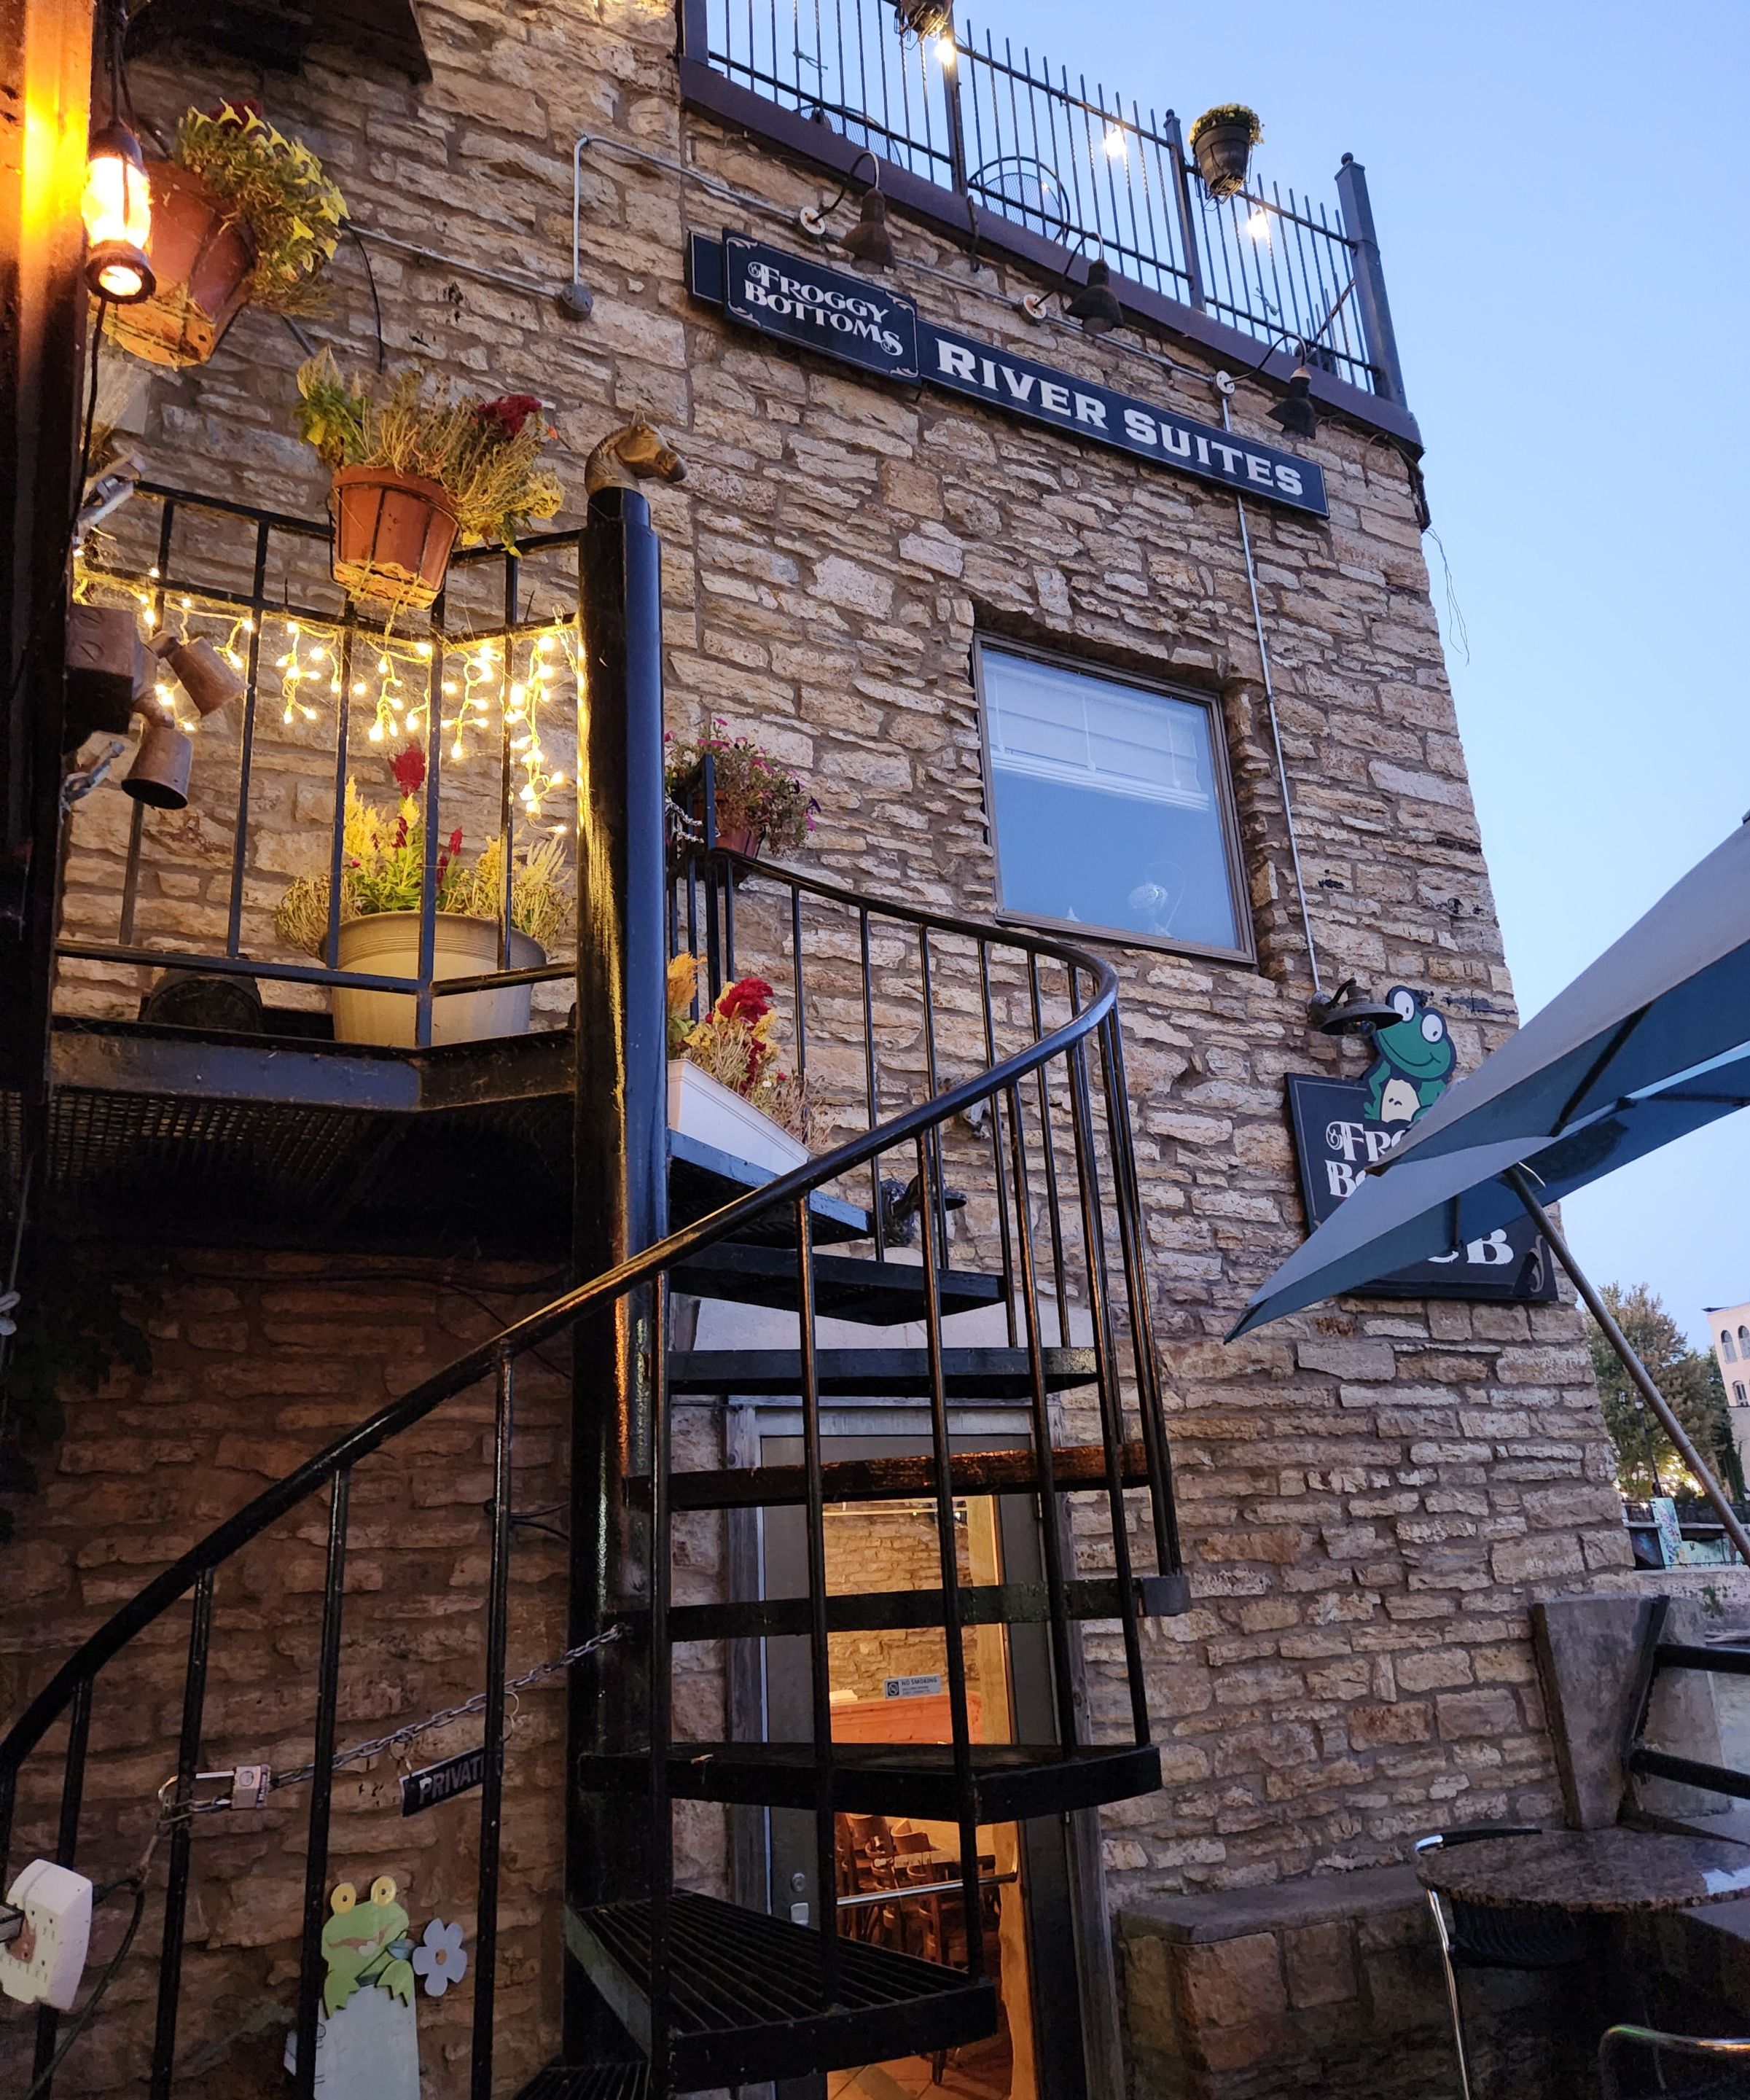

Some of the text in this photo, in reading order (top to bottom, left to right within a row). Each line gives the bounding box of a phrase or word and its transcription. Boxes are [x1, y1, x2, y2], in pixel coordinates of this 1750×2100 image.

[743, 279, 904, 356] BOTTOMS
[747, 261, 889, 324] FROGGY
[934, 337, 1303, 496] RIVER SUITES
[911, 1677, 938, 1685] SMOKING
[418, 1754, 485, 1805] PRIVAT
